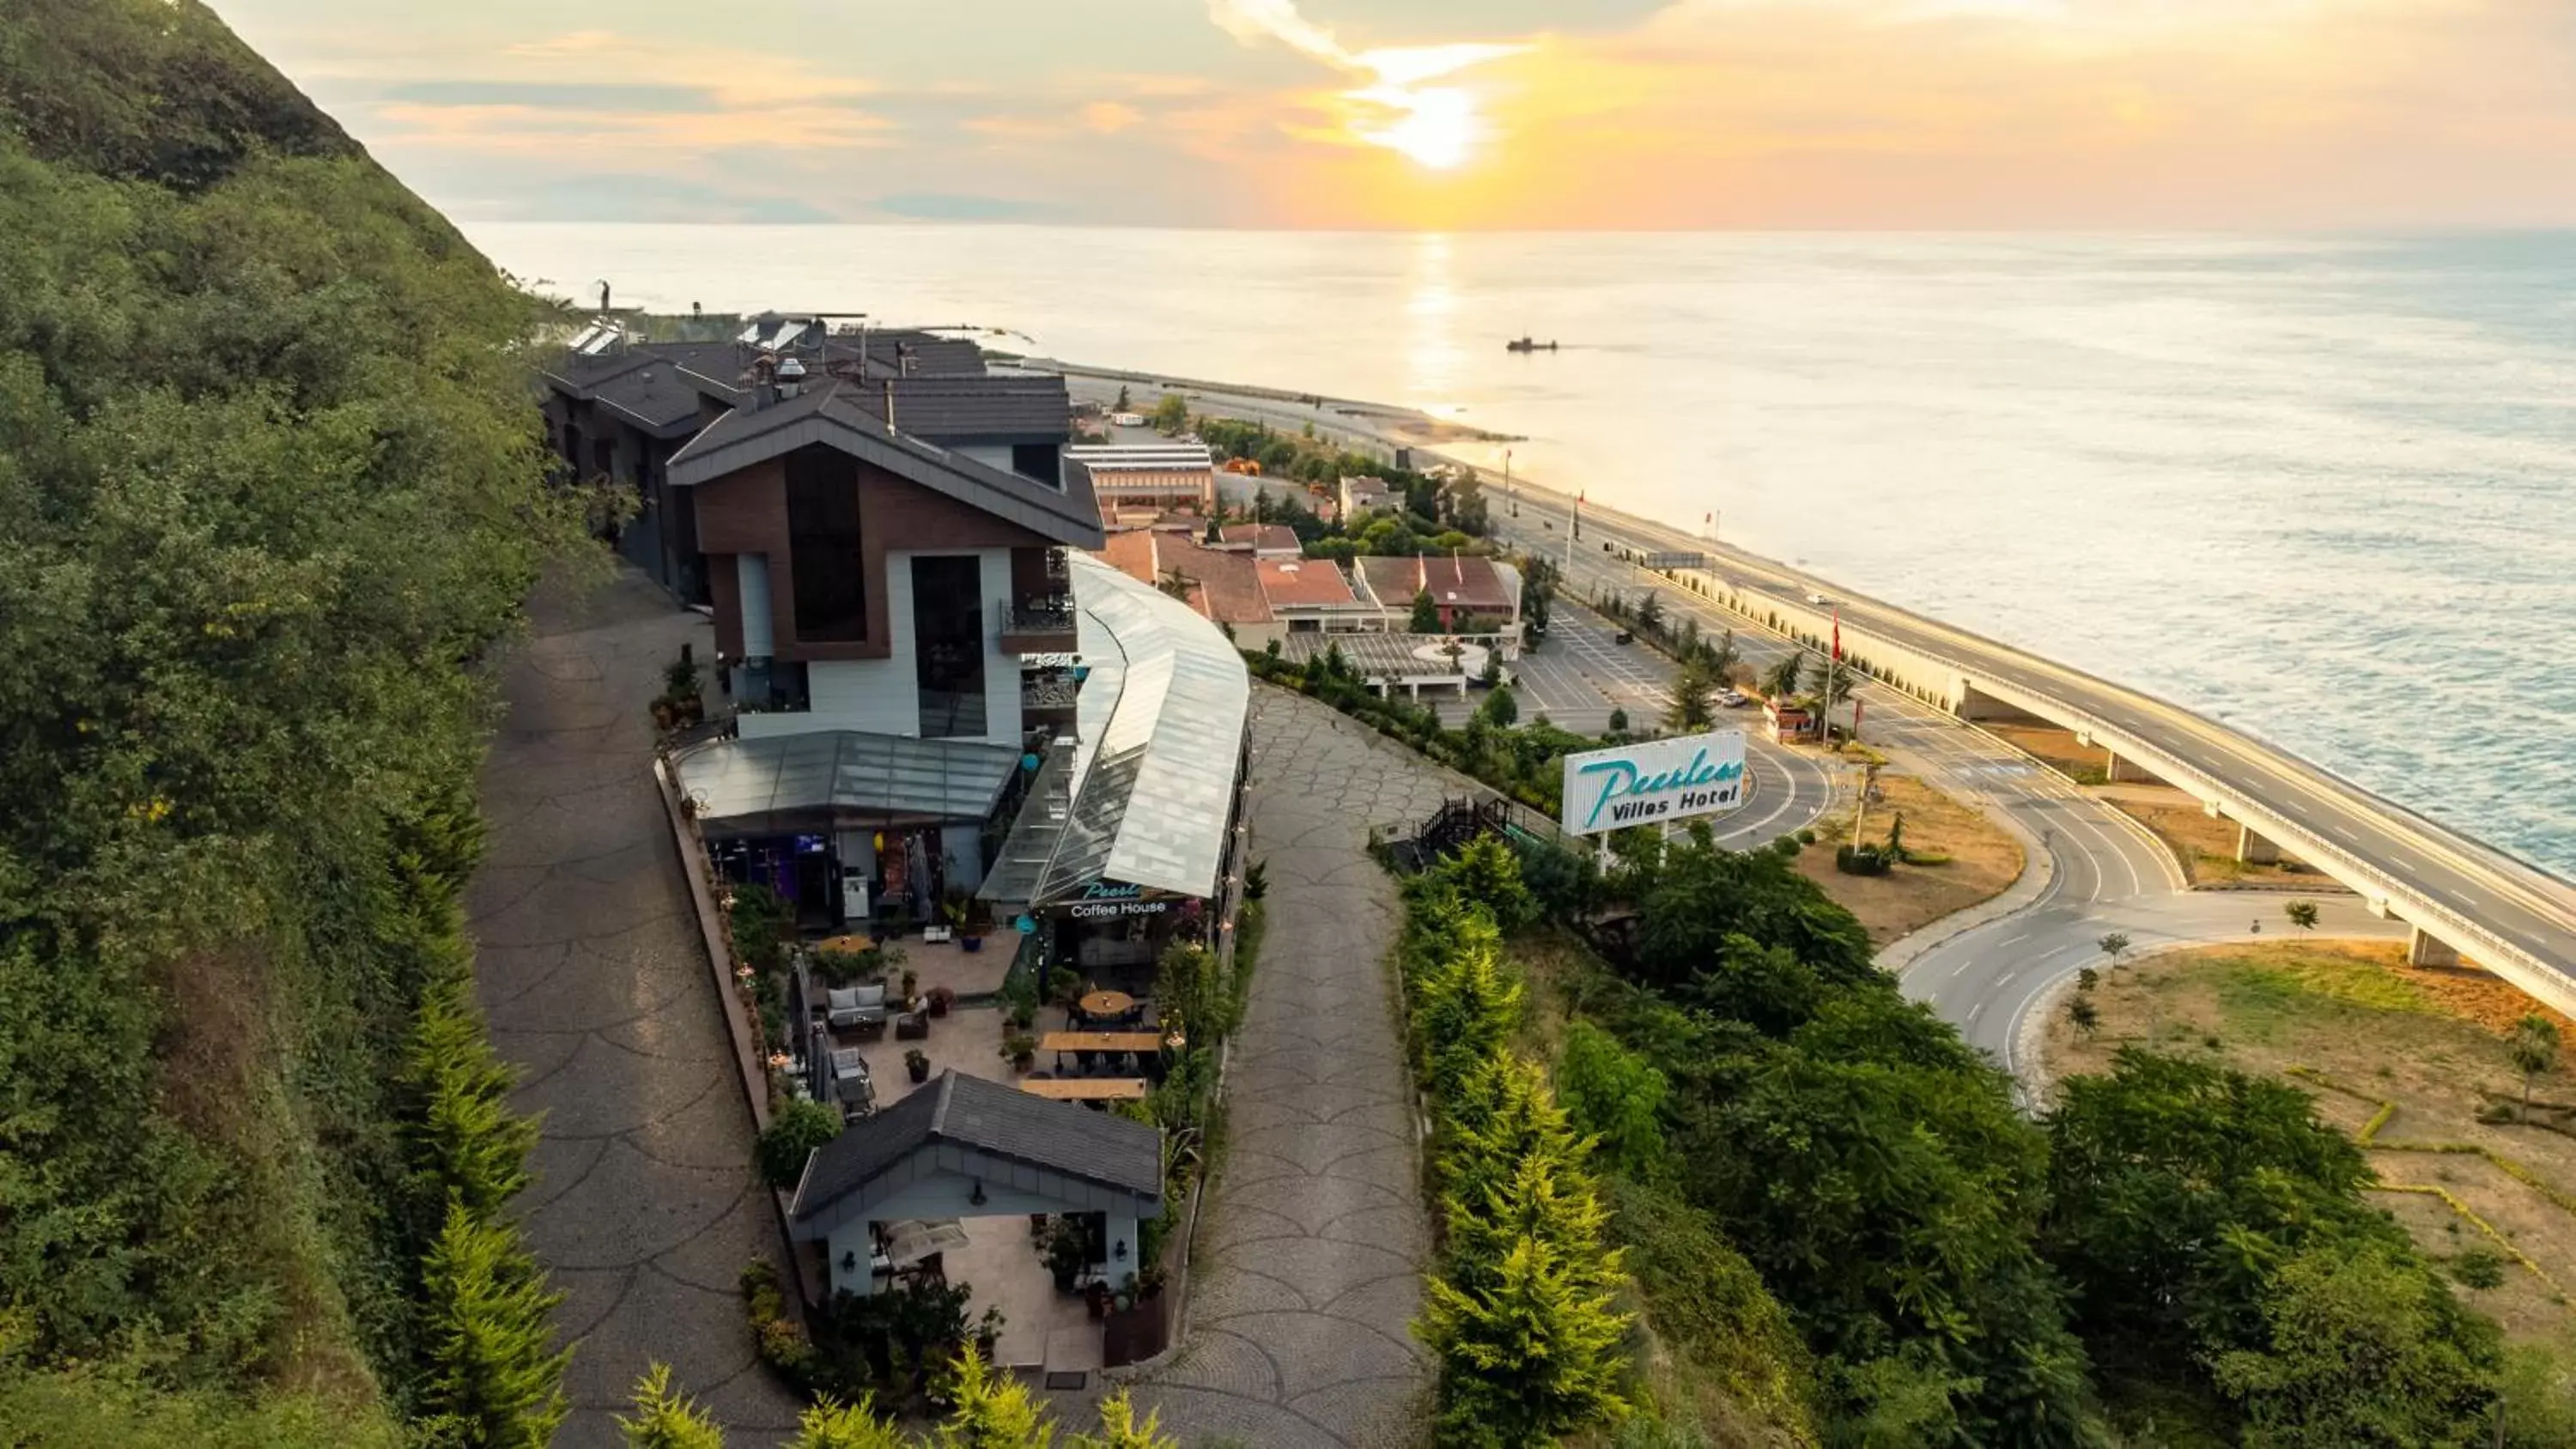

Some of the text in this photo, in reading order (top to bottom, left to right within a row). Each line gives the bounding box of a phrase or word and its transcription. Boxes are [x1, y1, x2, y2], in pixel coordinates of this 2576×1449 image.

[1613, 785, 1737, 821] Villas Hotel
[1072, 902, 1166, 917] Coffee House
